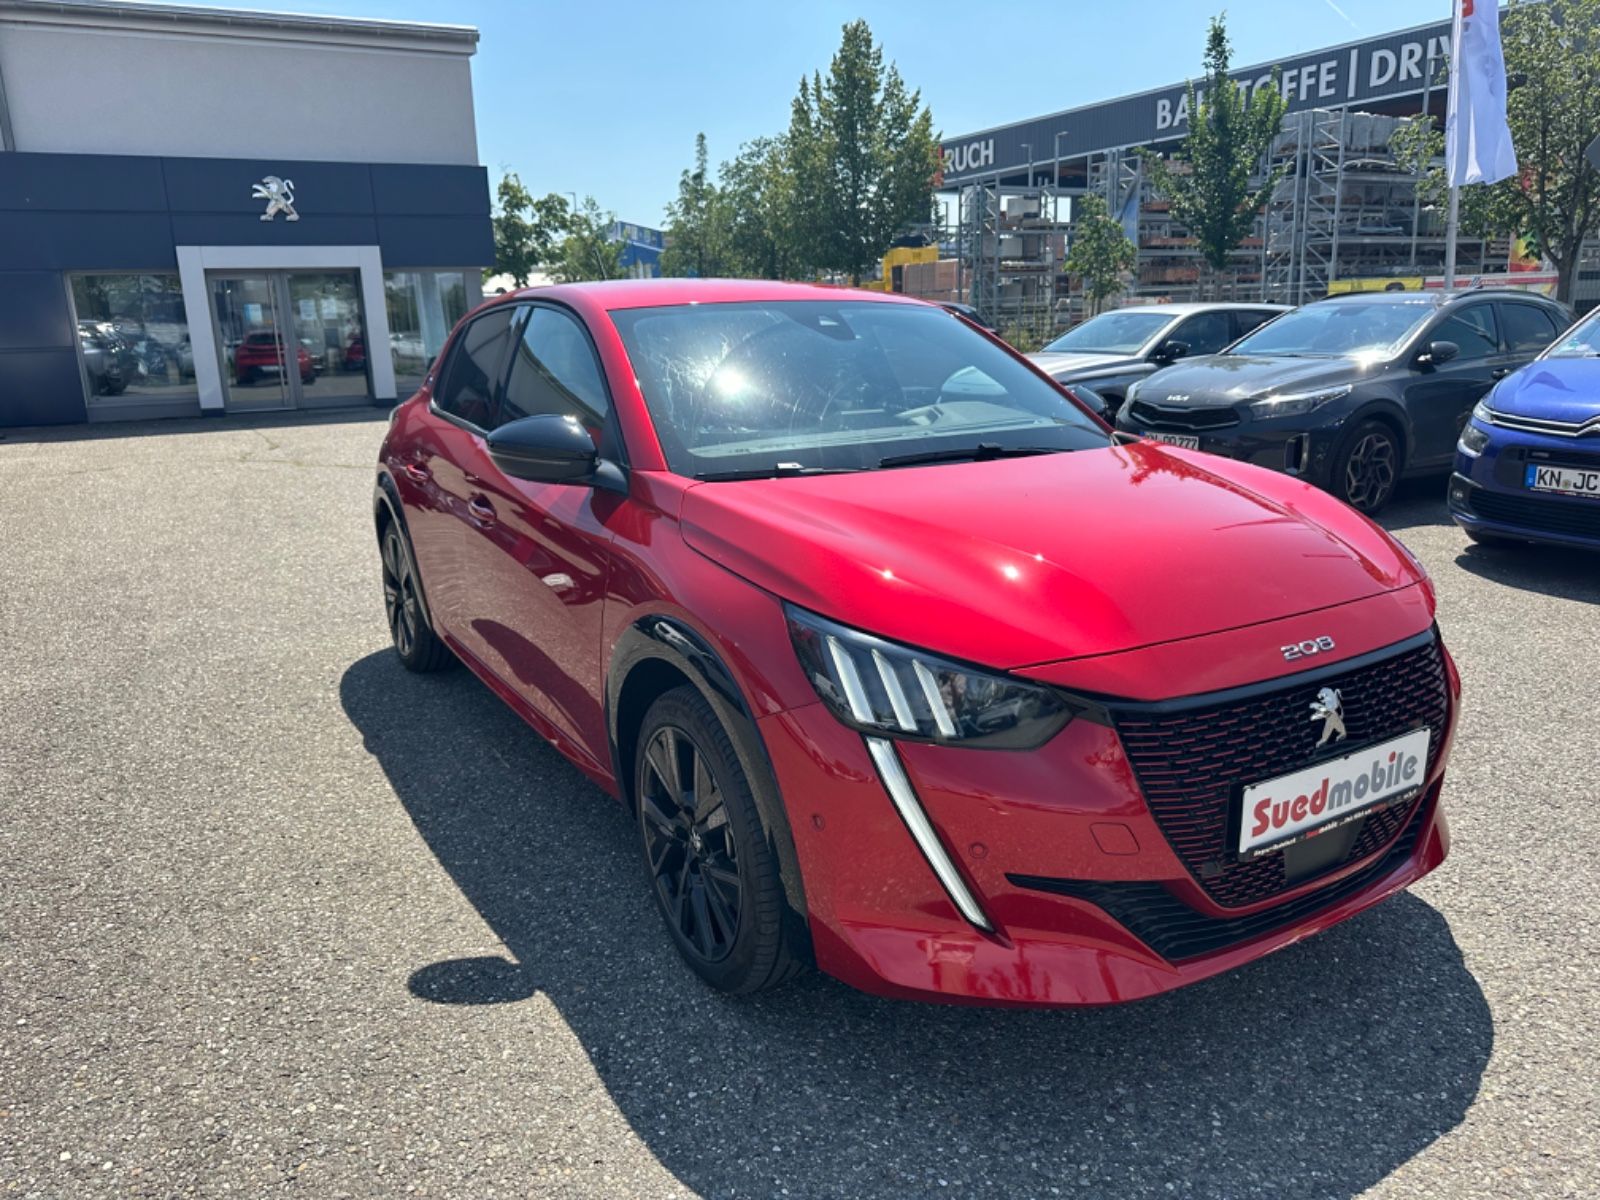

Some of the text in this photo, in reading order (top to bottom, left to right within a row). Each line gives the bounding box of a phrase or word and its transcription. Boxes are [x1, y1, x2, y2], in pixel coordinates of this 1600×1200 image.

[1536, 468, 1599, 491] KN JC
[1280, 635, 1335, 662] 208
[1251, 751, 1418, 838] Suedmobile
